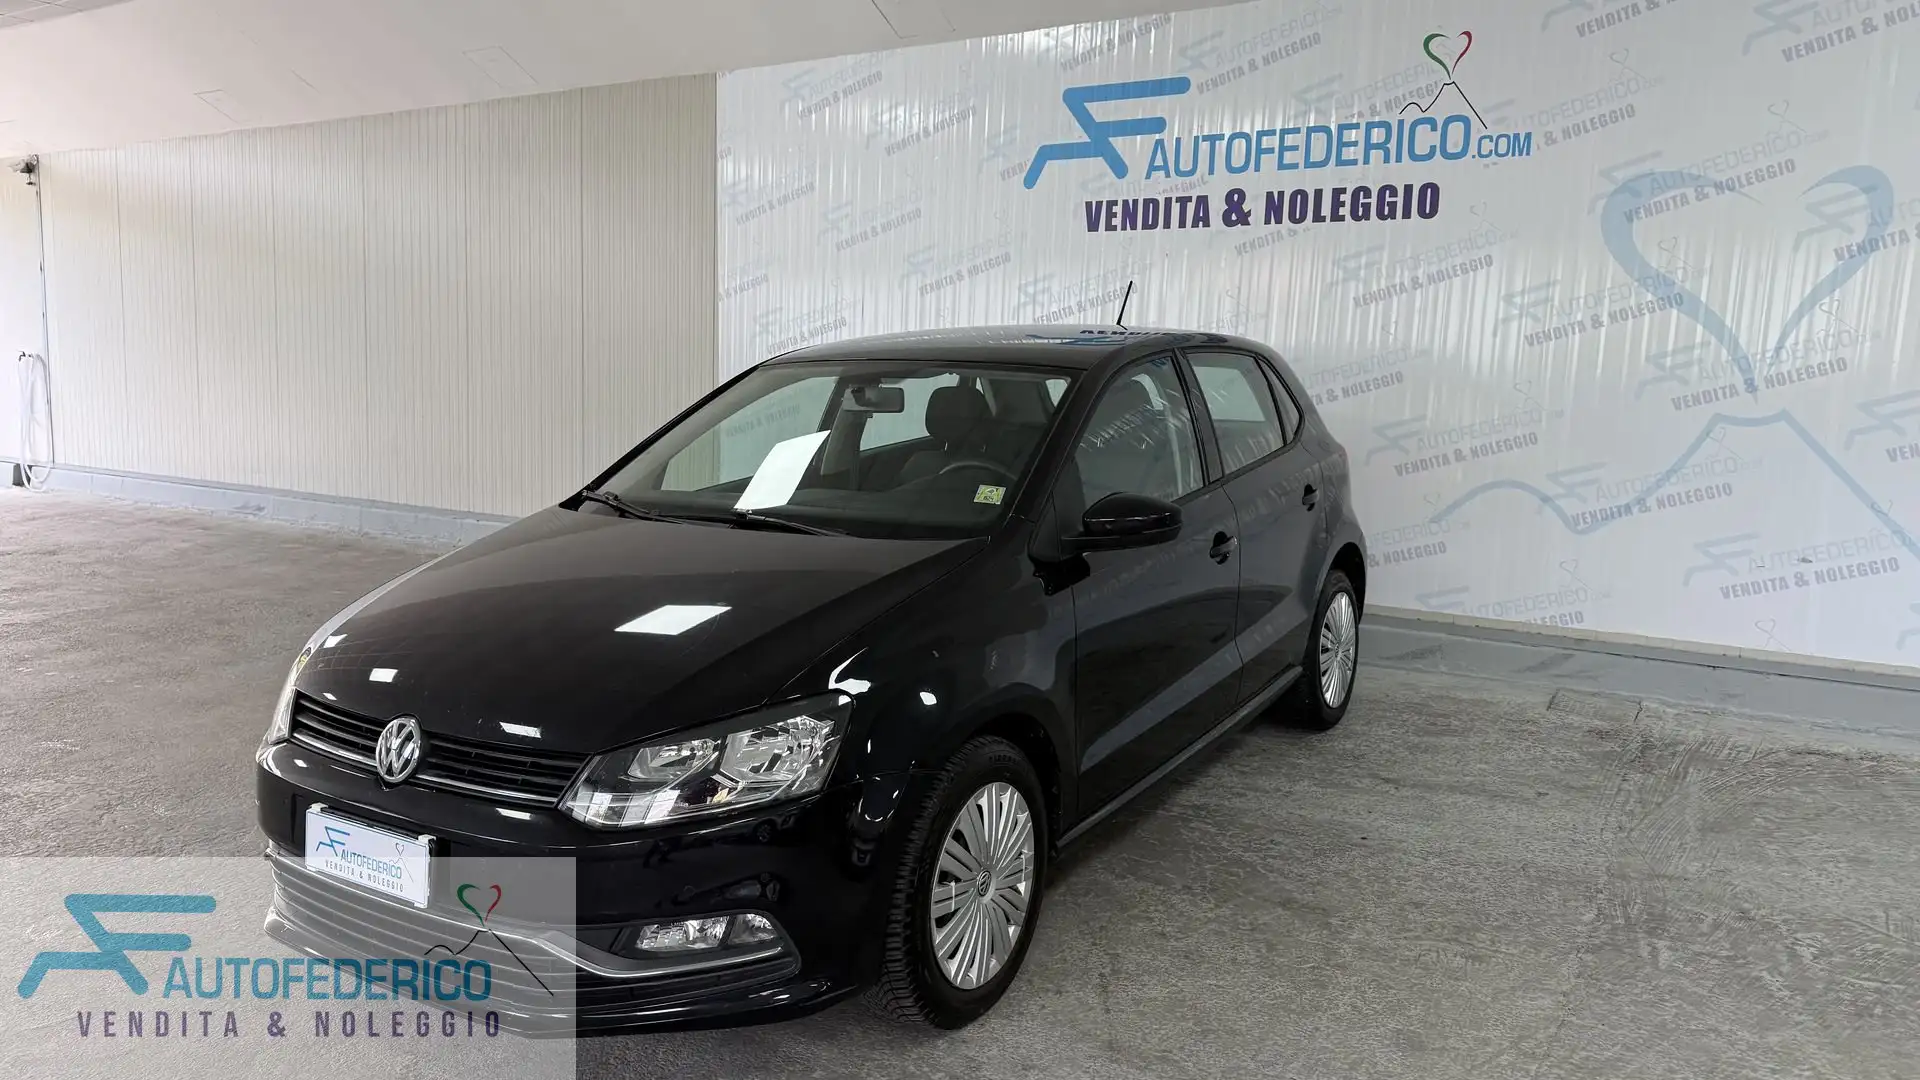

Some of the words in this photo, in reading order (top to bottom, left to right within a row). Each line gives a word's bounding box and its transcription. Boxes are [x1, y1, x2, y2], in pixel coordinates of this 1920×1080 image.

[1575, 5, 1642, 38] VENDITA
[1781, 25, 1857, 63] VENDITA
[1861, 16, 1880, 36] &
[1196, 67, 1246, 95] VENDITA
[1247, 55, 1260, 73] &
[1261, 31, 1322, 67] NOLEGGIO
[1543, 127, 1558, 148] &
[1562, 102, 1637, 142] NOLEGGIO
[1084, 194, 1211, 233] VENDITA
[1221, 187, 1251, 228] &
[1263, 181, 1441, 226] NOLEGGIO
[1623, 193, 1691, 225] VENDITA
[1694, 183, 1710, 203] &
[1712, 157, 1797, 196] NOLEGGIO
[1234, 231, 1284, 258] VENDITA
[1833, 228, 1911, 262] VENDITA
[1352, 283, 1409, 310] VENDITA
[1411, 273, 1424, 291] &
[1427, 254, 1495, 287] NOLEGGIO
[1524, 318, 1587, 348] VENDITA
[1590, 312, 1606, 330] &
[1608, 291, 1685, 324] NOLEGGIO
[1341, 370, 1405, 399] NOLEGGIO
[1670, 384, 1740, 412] VENDITA
[1744, 377, 1760, 394] &
[1763, 356, 1849, 389] NOLEGGIO
[1393, 451, 1452, 478] VENDITA
[1454, 447, 1468, 465] &
[1469, 431, 1538, 460] NOLEGGIO
[1569, 502, 1633, 531] VENDITA
[1636, 497, 1653, 515] &
[1655, 481, 1734, 512] NOLEGGIO
[1382, 540, 1447, 566] NOLEGGIO
[1719, 574, 1790, 600] VENDITA
[1793, 570, 1811, 589] &
[1813, 556, 1901, 586] NOLEGGIO
[341, 848, 402, 880] AUTOFEDERICO
